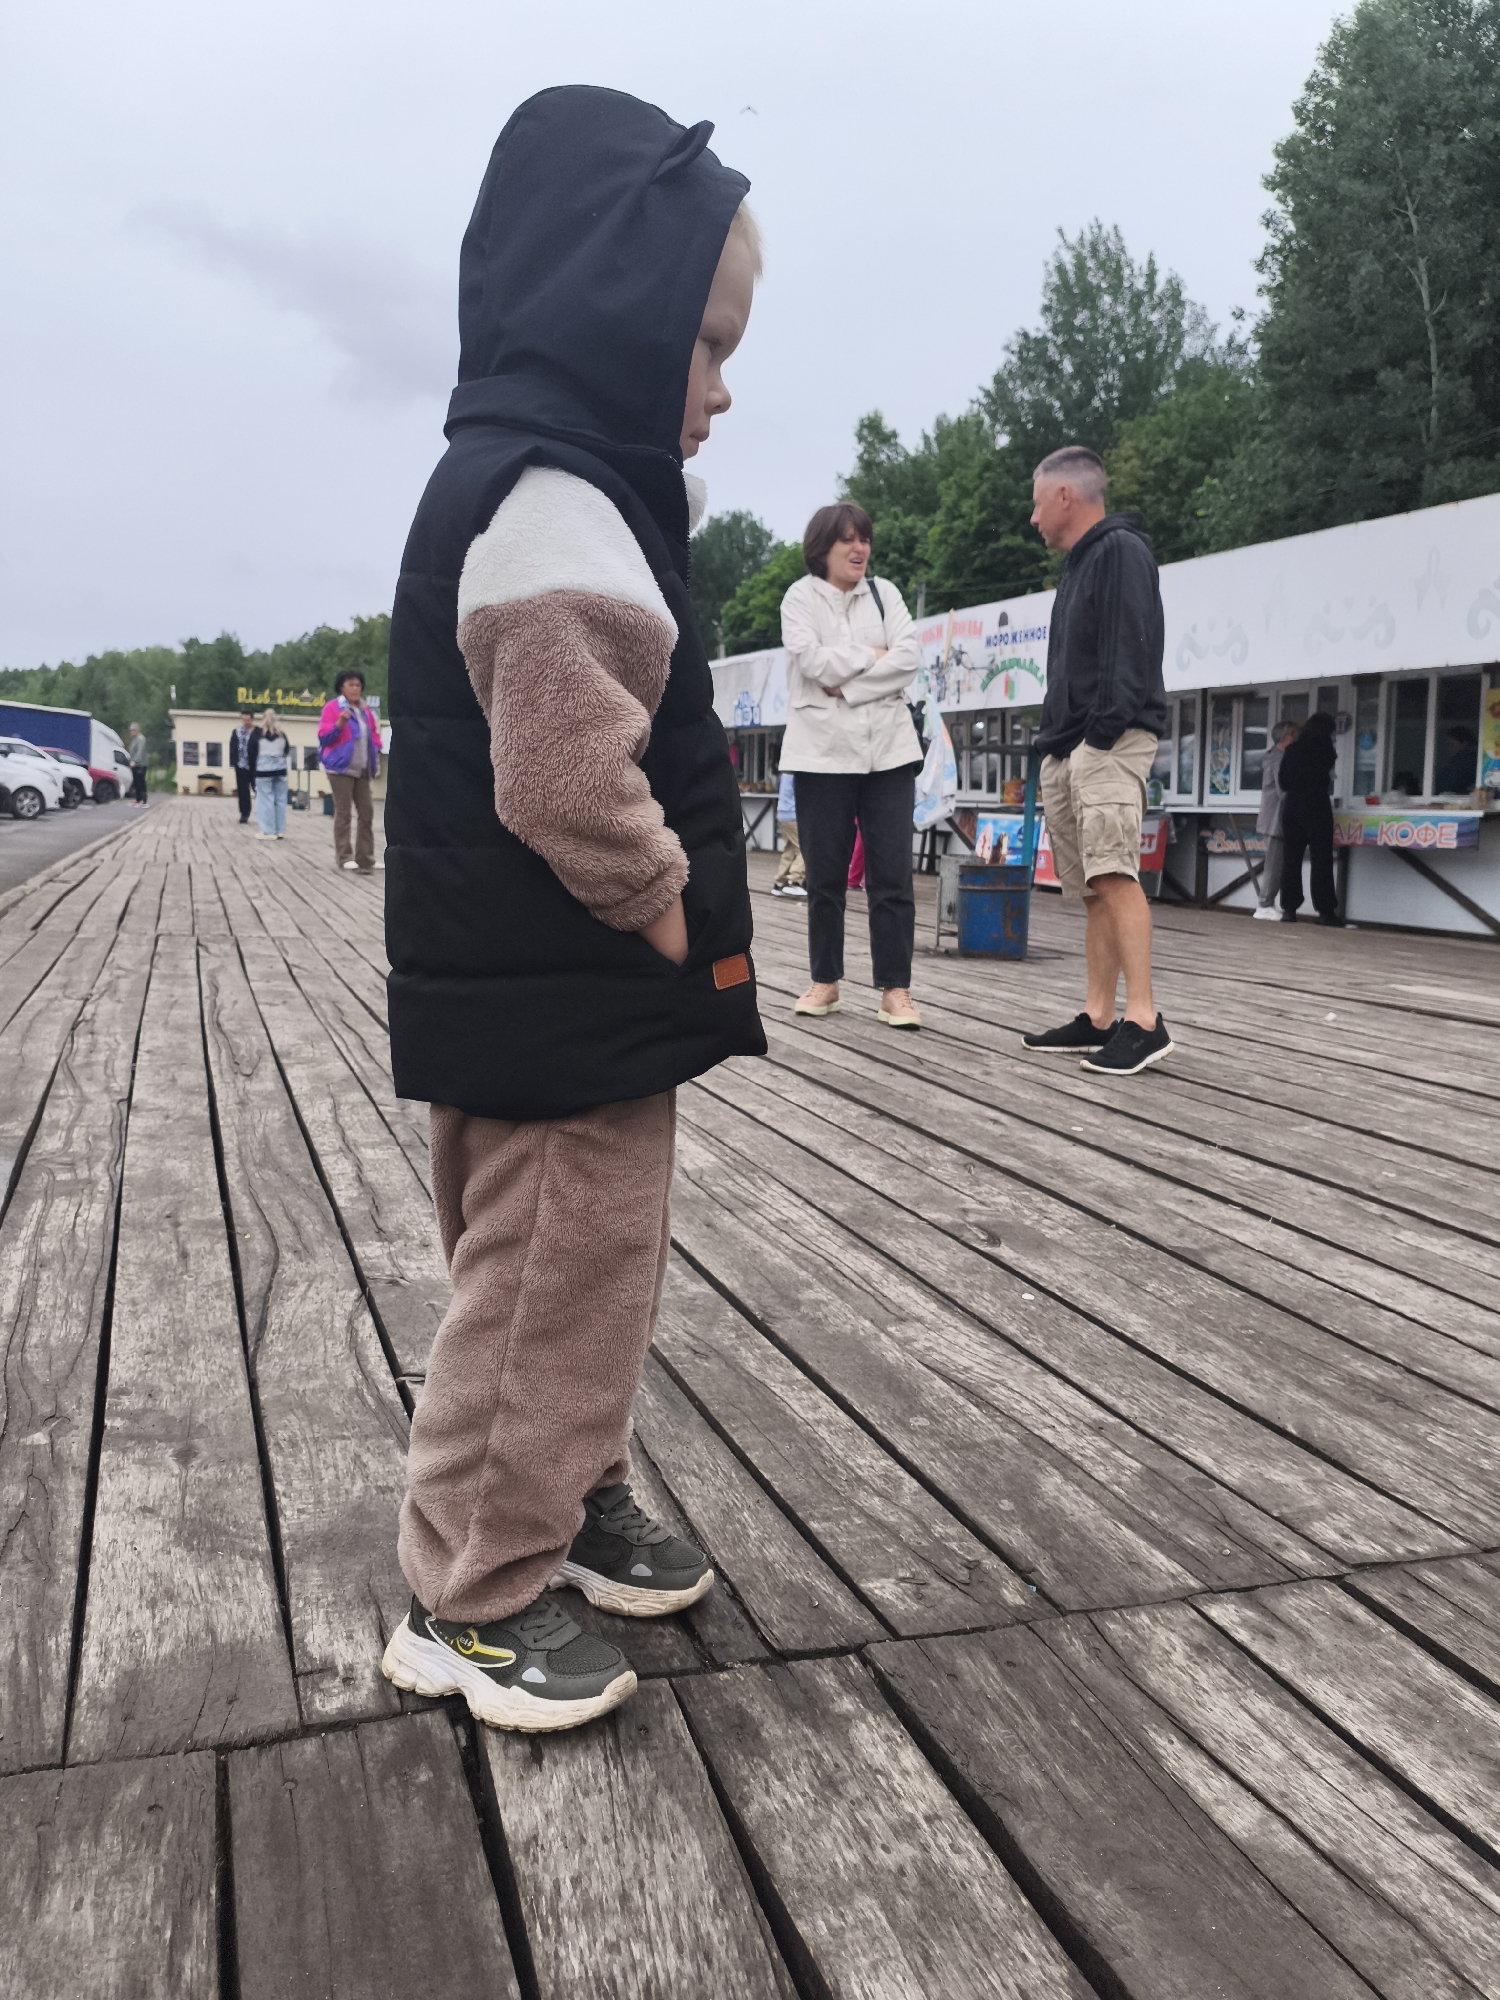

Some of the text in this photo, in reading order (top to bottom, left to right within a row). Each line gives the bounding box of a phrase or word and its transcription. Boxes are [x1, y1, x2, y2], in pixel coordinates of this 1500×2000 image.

[985, 625, 1047, 649] МОРОЖЕННОЕ
[1332, 818, 1459, 849] АЙ КОФЕ
